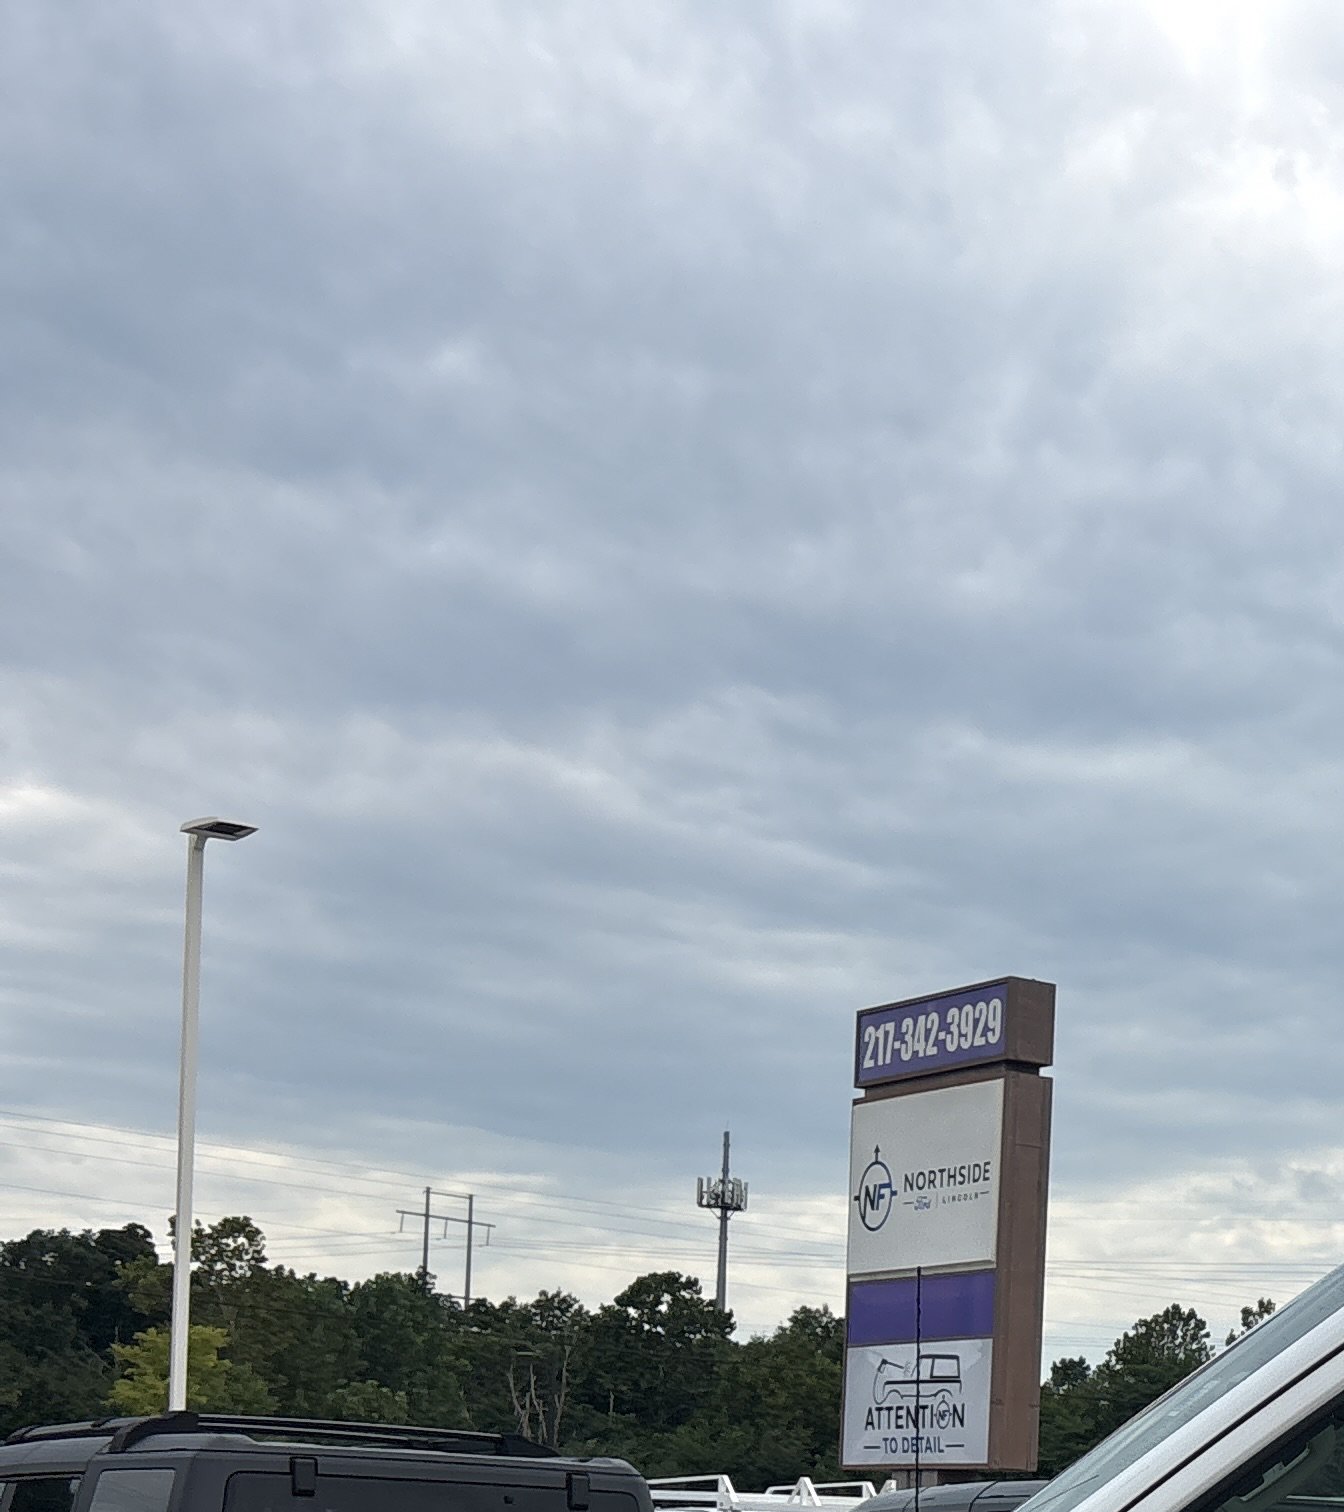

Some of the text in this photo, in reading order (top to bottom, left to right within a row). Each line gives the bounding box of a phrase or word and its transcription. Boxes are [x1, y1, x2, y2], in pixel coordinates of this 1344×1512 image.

[863, 998, 1002, 1069] 217-342-3929
[903, 1161, 991, 1193] NORTHSIDE
[864, 1402, 966, 1430] ATTENTION
[882, 1436, 945, 1454] TO DETAIL
